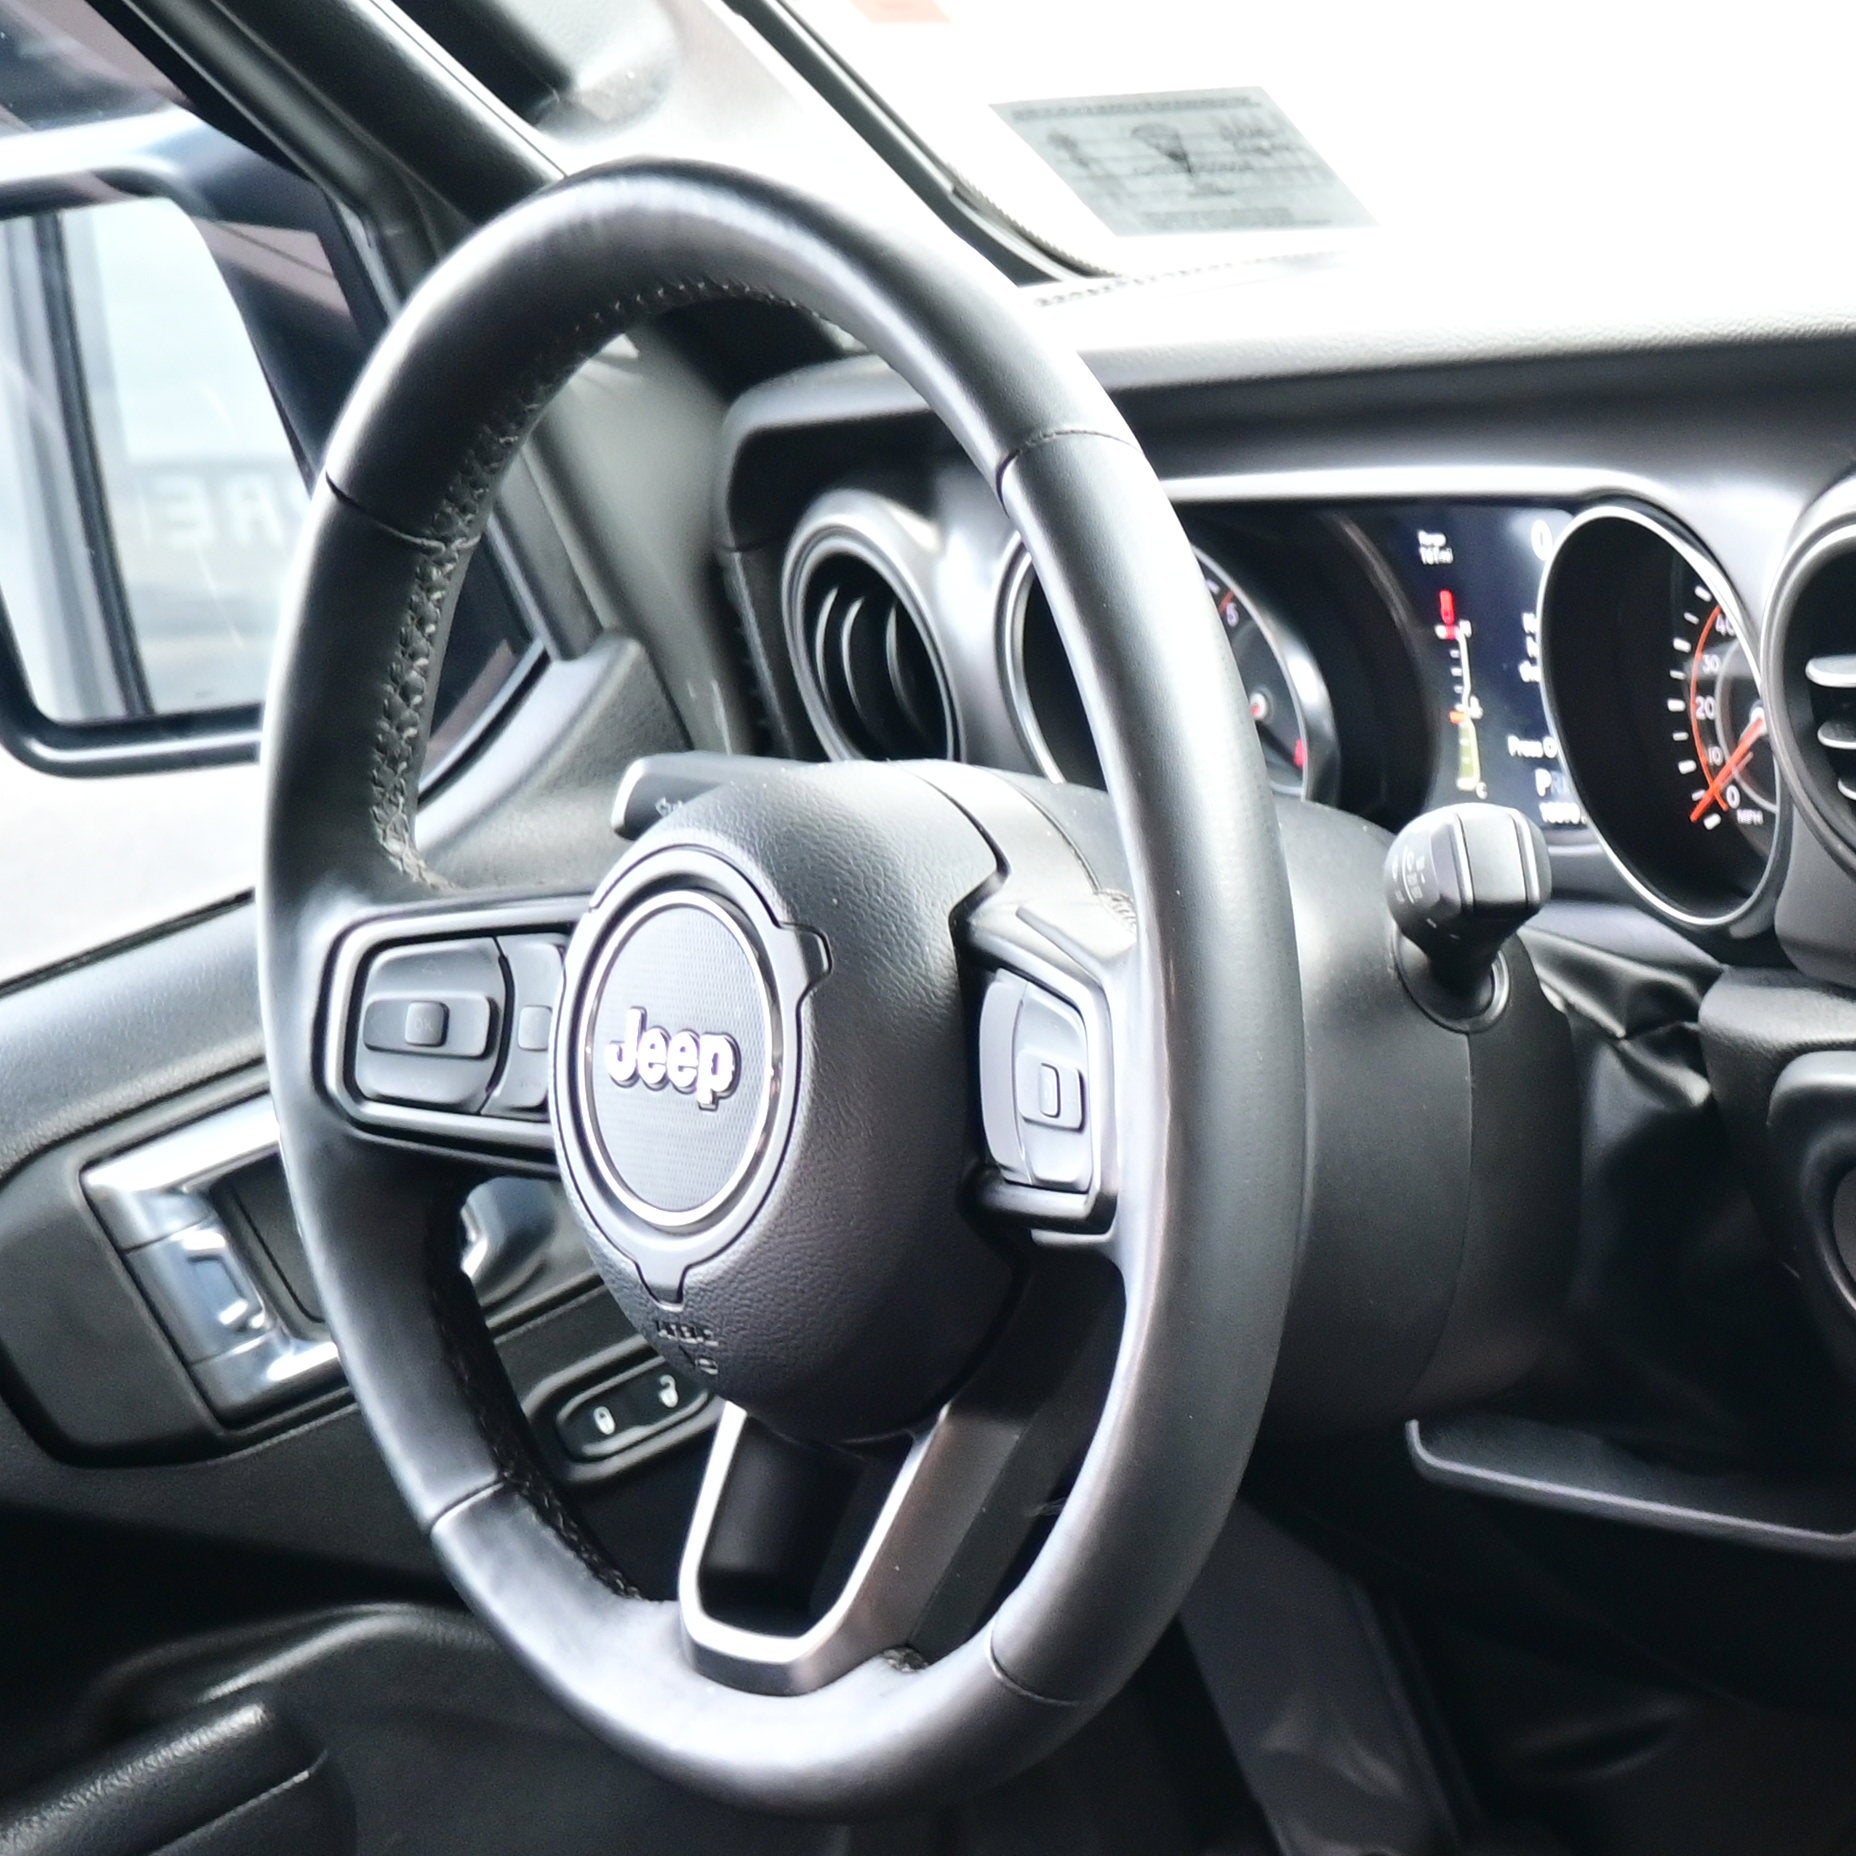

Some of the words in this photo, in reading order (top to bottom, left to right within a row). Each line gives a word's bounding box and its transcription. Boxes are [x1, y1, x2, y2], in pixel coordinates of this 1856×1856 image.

[1695, 695, 1716, 720] 20
[1707, 746, 1724, 766] 10
[1725, 785, 1740, 809] 0
[1736, 809, 1764, 825] MPH
[605, 1006, 742, 1112] Jeep
